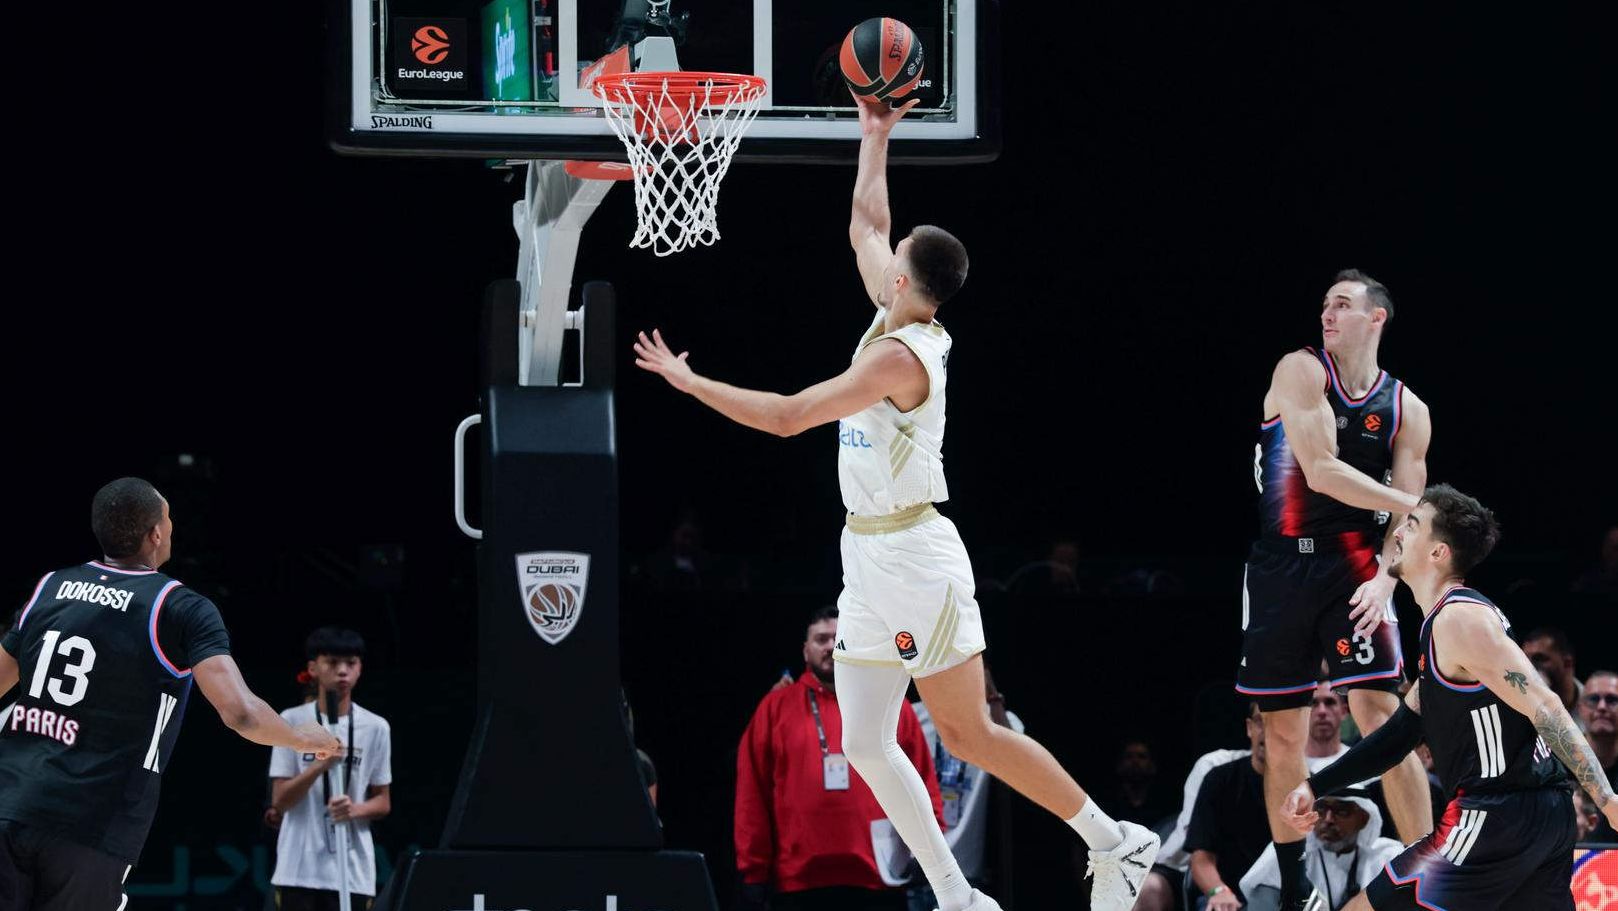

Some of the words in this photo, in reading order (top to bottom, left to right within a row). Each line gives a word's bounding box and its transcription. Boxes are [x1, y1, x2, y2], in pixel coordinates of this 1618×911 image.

[398, 68, 464, 82] EuroLeague
[371, 115, 432, 129] SPALDING
[526, 565, 580, 574] DUBAI
[55, 580, 135, 612] DOKOSSI
[1352, 630, 1375, 665] 3
[28, 630, 97, 707] 13
[11, 704, 80, 746] PARIS
